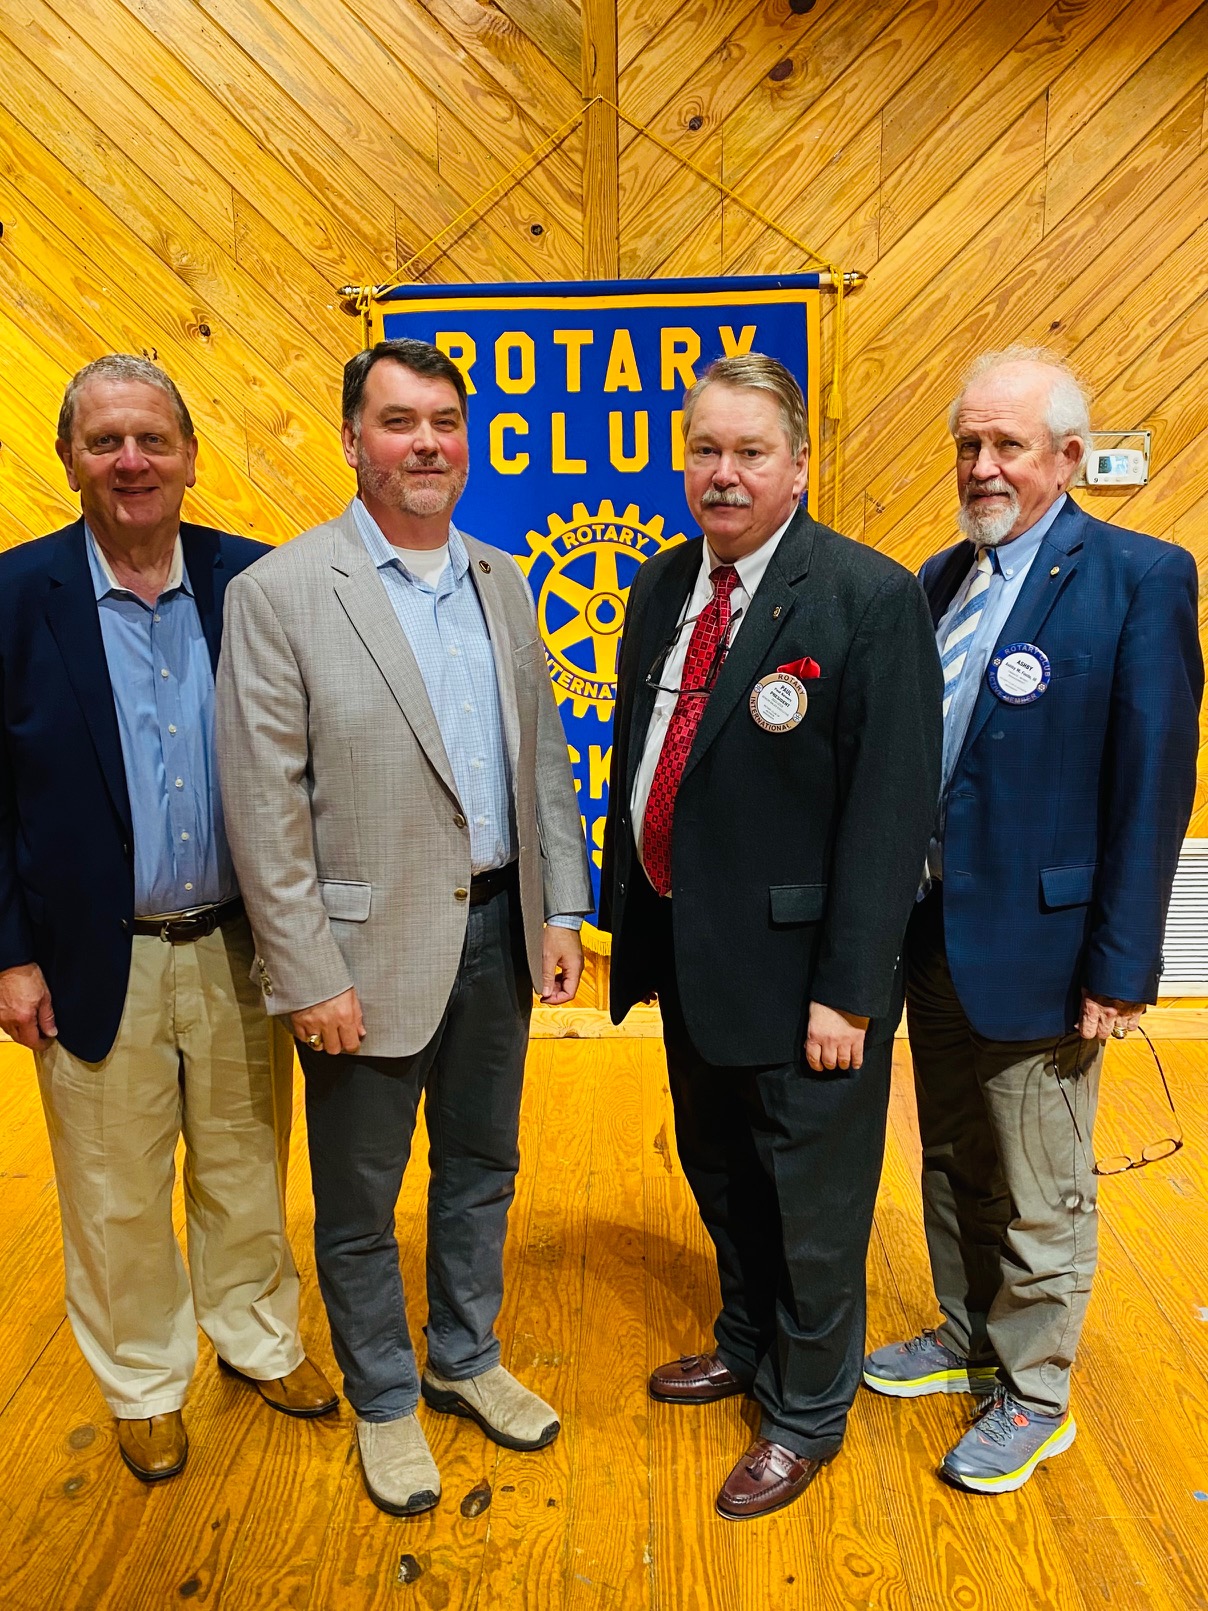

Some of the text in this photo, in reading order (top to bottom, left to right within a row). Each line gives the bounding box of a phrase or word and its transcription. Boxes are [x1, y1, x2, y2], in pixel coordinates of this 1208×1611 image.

[435, 325, 757, 395] ROTARY
[562, 525, 650, 550] ROTARY
[1004, 644, 1039, 655] ROTARY
[1039, 654, 1051, 677] CLUB
[1016, 660, 1034, 671] ASHBY
[777, 673, 805, 695] ROTARY
[780, 685, 792, 697] PAUL
[990, 671, 1004, 697] ACTIVE
[770, 691, 790, 708] PRESIDENT
[751, 696, 792, 731] INTERNATIONAL
